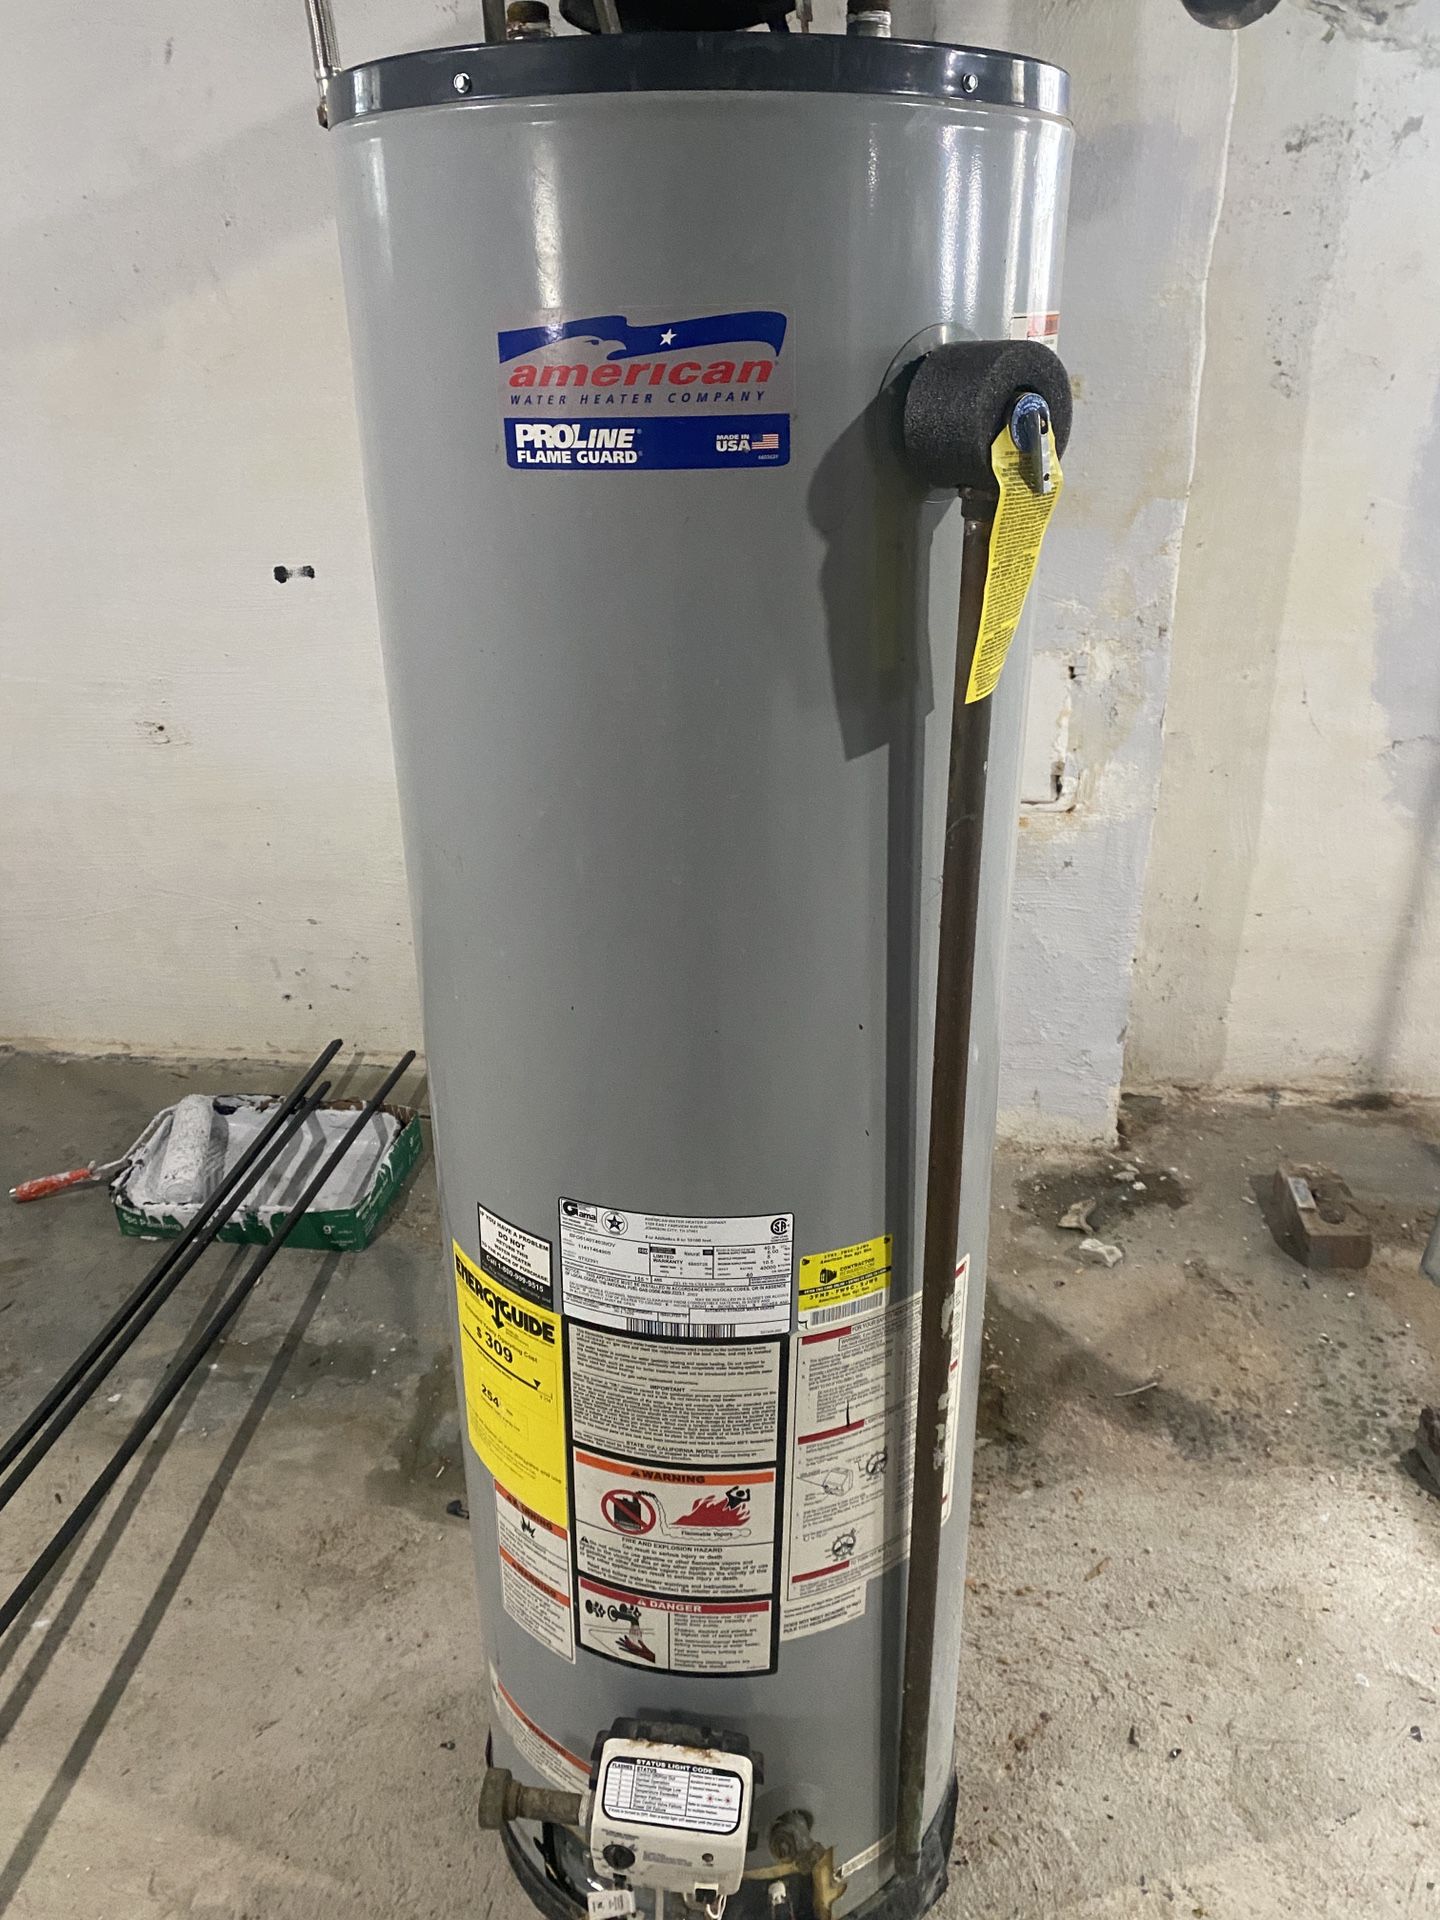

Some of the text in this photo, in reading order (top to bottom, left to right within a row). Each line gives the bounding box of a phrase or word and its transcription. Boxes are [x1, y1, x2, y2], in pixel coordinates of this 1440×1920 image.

[508, 359, 774, 388] american
[510, 390, 766, 405] WATER HEATER COMPANY
[715, 440, 751, 452] USA
[516, 450, 638, 464] FLAME GUARD
[485, 1213, 496, 1225] YOU
[497, 1221, 512, 1235] HAVE
[518, 1234, 549, 1251] PROBLEM
[498, 1231, 525, 1251] DO NOT
[488, 1244, 496, 1254] THE
[496, 1252, 511, 1265] PLACE
[494, 1243, 532, 1268] WATER HEATER
[496, 1237, 529, 1260] RETURN THIS
[486, 1254, 497, 1266] Call
[485, 1332, 513, 1364] 309
[523, 1351, 538, 1363] Cost
[649, 1384, 685, 1392] IMPORTANT
[481, 1383, 499, 1408] 254
[626, 1440, 645, 1448] STATE
[657, 1445, 694, 1454] CALIFORNIA
[642, 1470, 706, 1484] WARNING
[621, 1536, 635, 1545] FIRE
[637, 1540, 653, 1549] AND
[653, 1543, 692, 1553] EXPLOSION
[658, 1550, 680, 1558] serious
[680, 1553, 697, 1561] injury
[650, 1601, 702, 1613] DANGER
[611, 1762, 633, 1770] FLASHES
[636, 1759, 713, 1775] STATUS LIGHT CODE
[637, 1766, 657, 1774] STATUS
